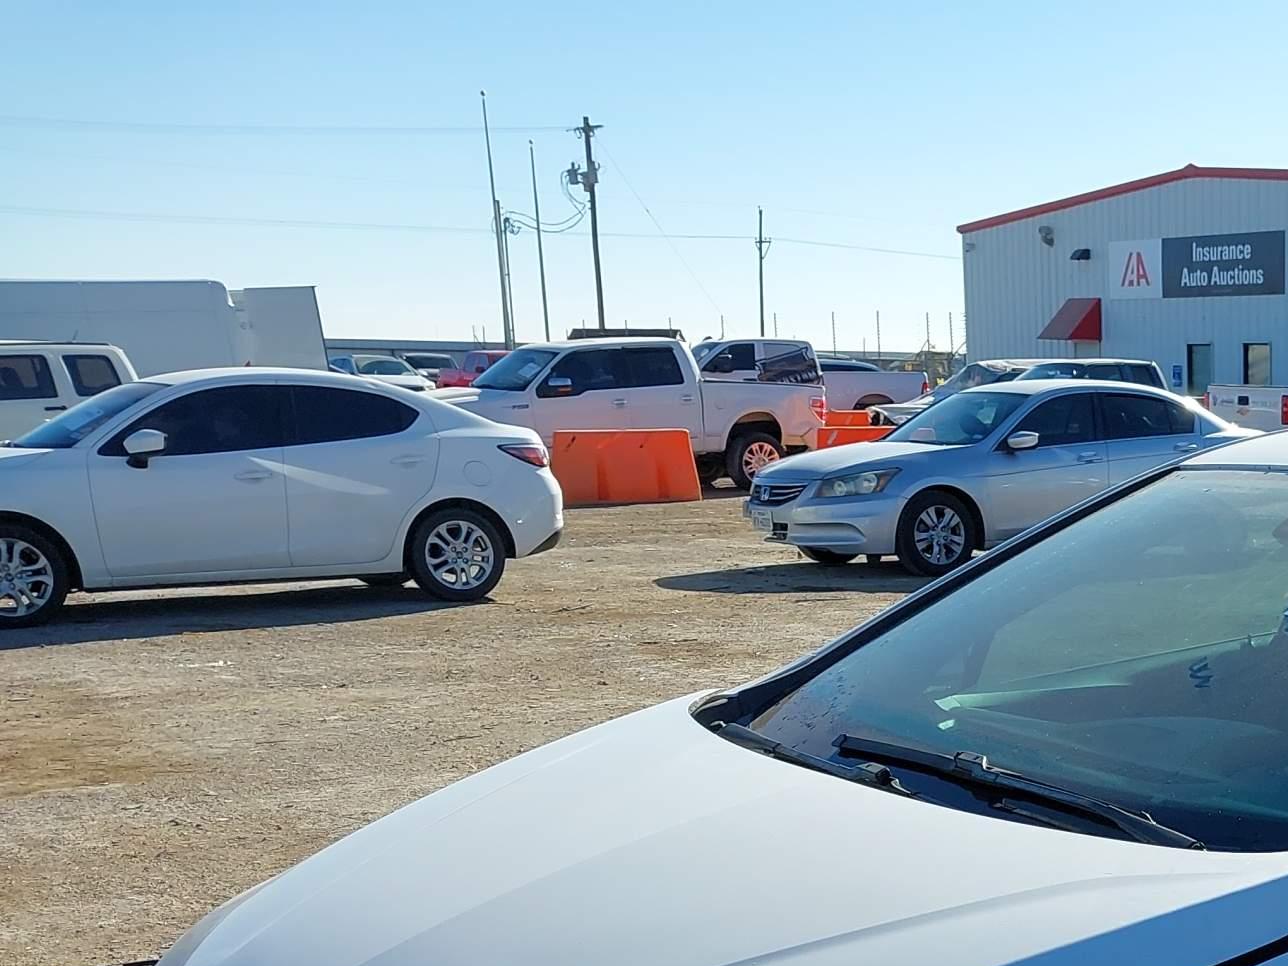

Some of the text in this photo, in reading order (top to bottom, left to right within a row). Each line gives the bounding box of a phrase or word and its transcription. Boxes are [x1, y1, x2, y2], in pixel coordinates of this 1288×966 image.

[1192, 241, 1252, 262] Insurance
[1181, 264, 1264, 288] Auto Auctions
